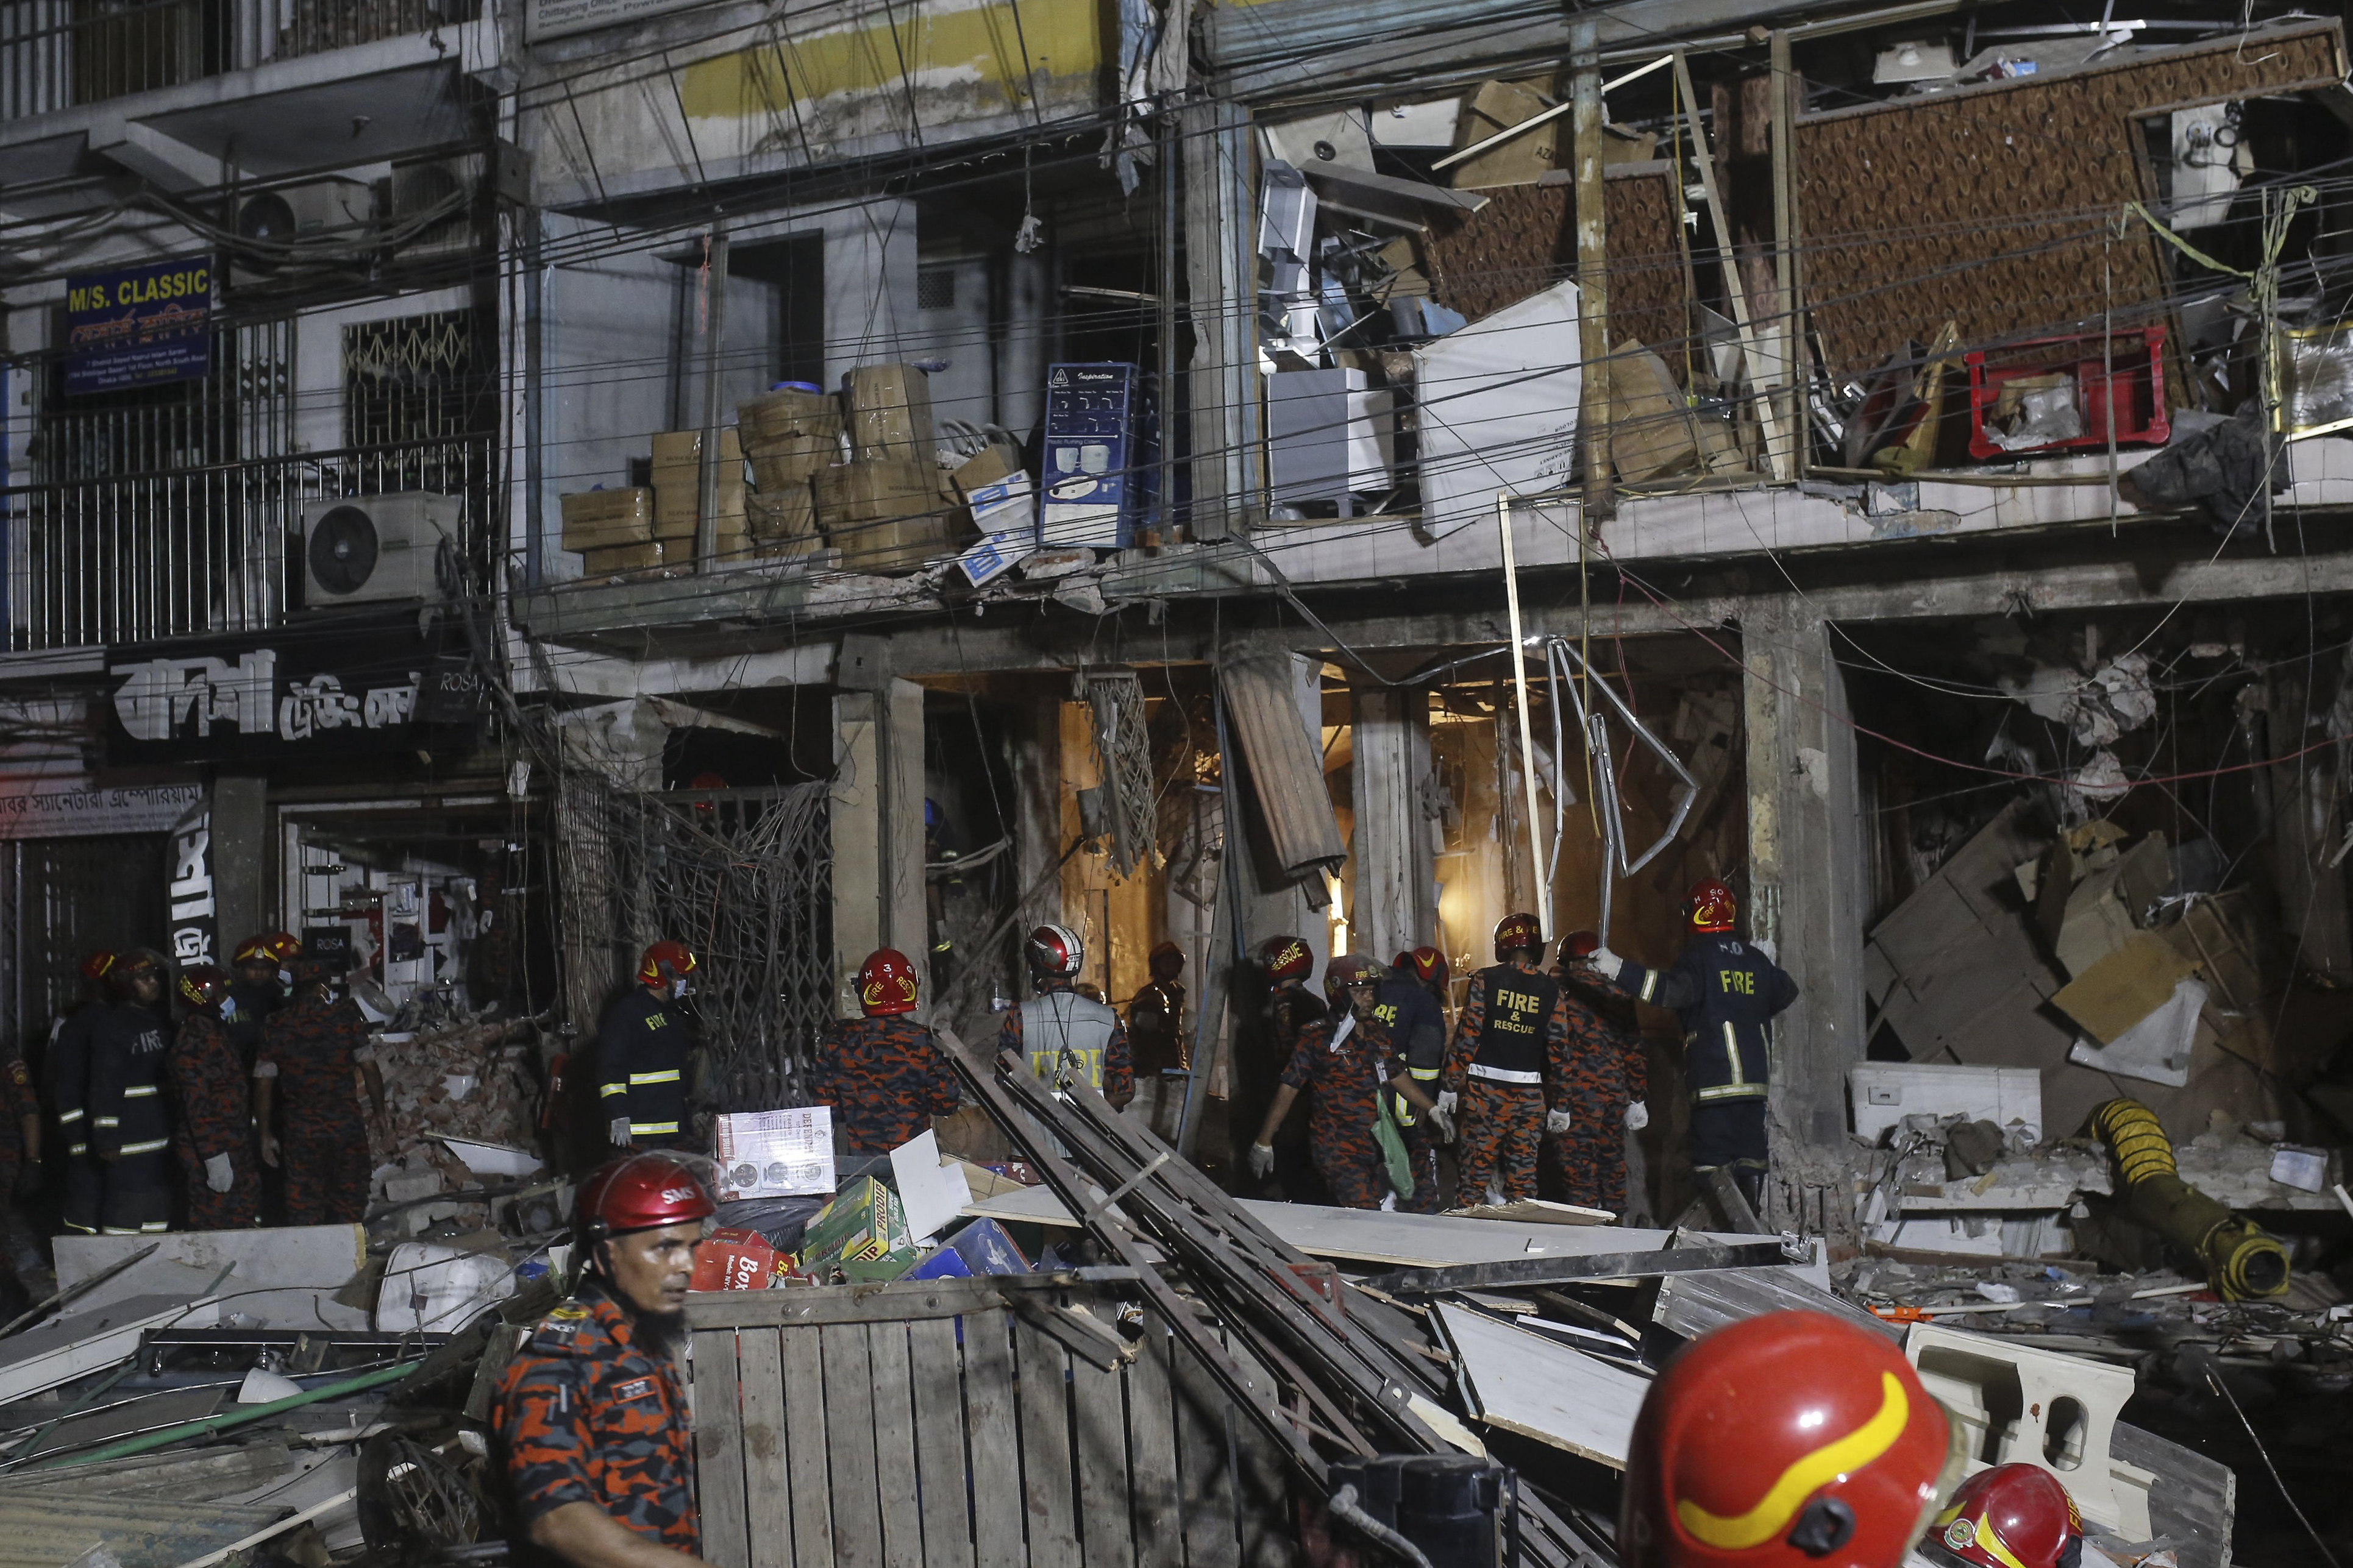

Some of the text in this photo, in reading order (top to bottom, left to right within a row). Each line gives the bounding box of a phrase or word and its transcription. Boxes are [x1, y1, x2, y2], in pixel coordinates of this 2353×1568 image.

[69, 269, 208, 313] M/S. CLASSIC
[440, 672, 478, 692] ROSA
[110, 649, 276, 740] বাদশা
[316, 938, 344, 951] ROSA
[1720, 970, 1754, 995] FIRE
[1497, 989, 1540, 1014] FIRE
[1510, 1011, 1520, 1022] &
[1494, 1020, 1536, 1034] RESCUE
[661, 1187, 696, 1204] SMS
[876, 1183, 886, 1231] PRODIP
[726, 1255, 735, 1275] Model:
